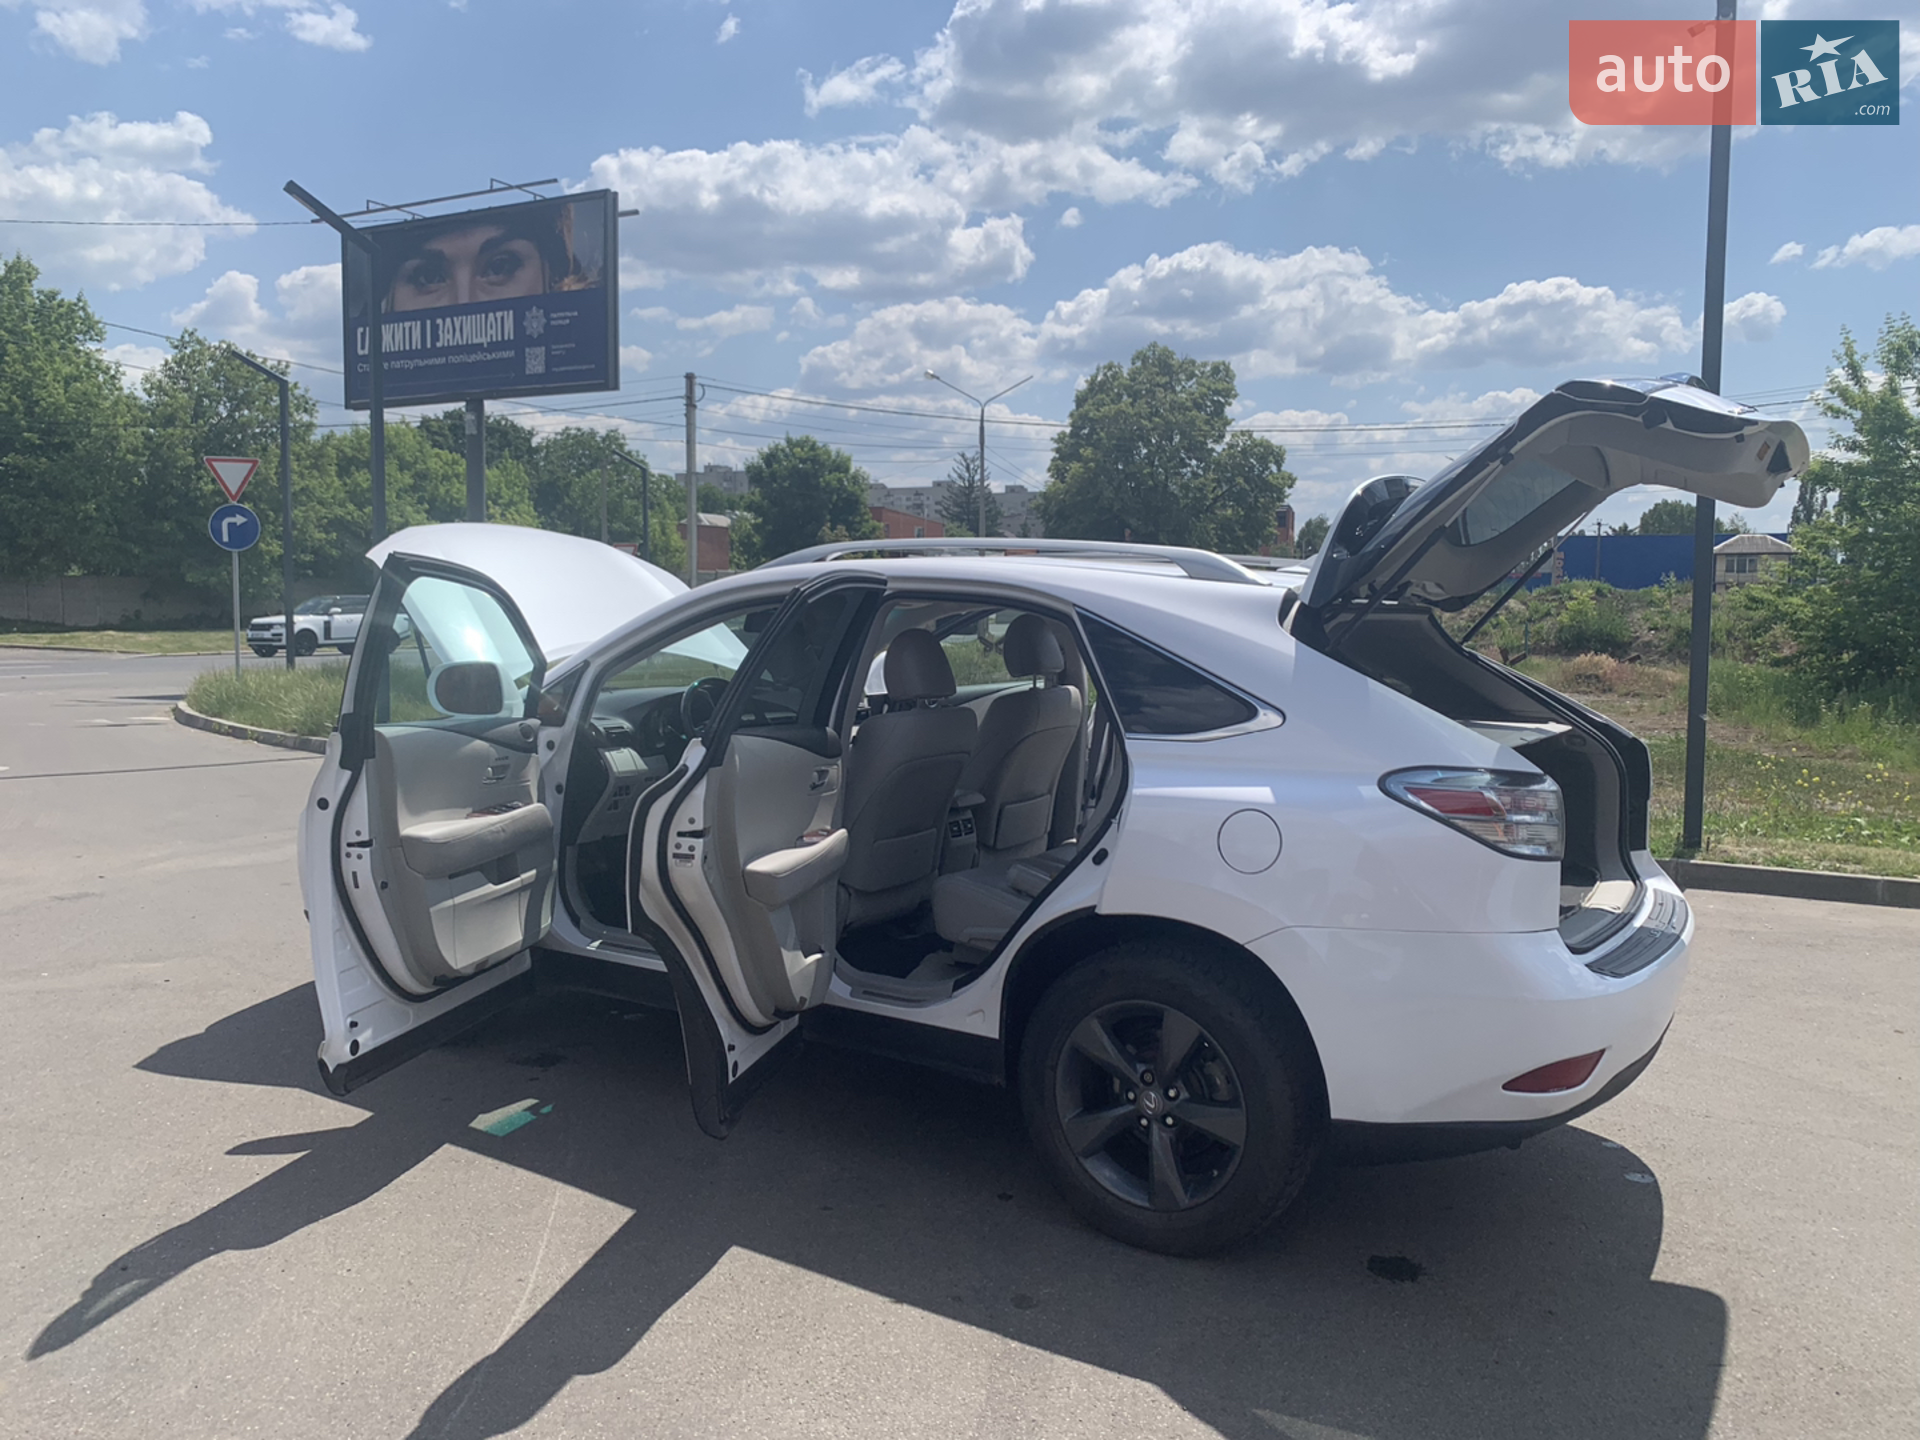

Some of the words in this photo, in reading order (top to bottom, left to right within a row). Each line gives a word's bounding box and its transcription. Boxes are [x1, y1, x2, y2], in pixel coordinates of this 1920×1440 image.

[357, 321, 422, 356] СЛЖИТИ
[436, 310, 514, 348] ЗАХИЩАТИ
[391, 356, 446, 370] патрульними
[448, 349, 515, 364] поліцейськими
